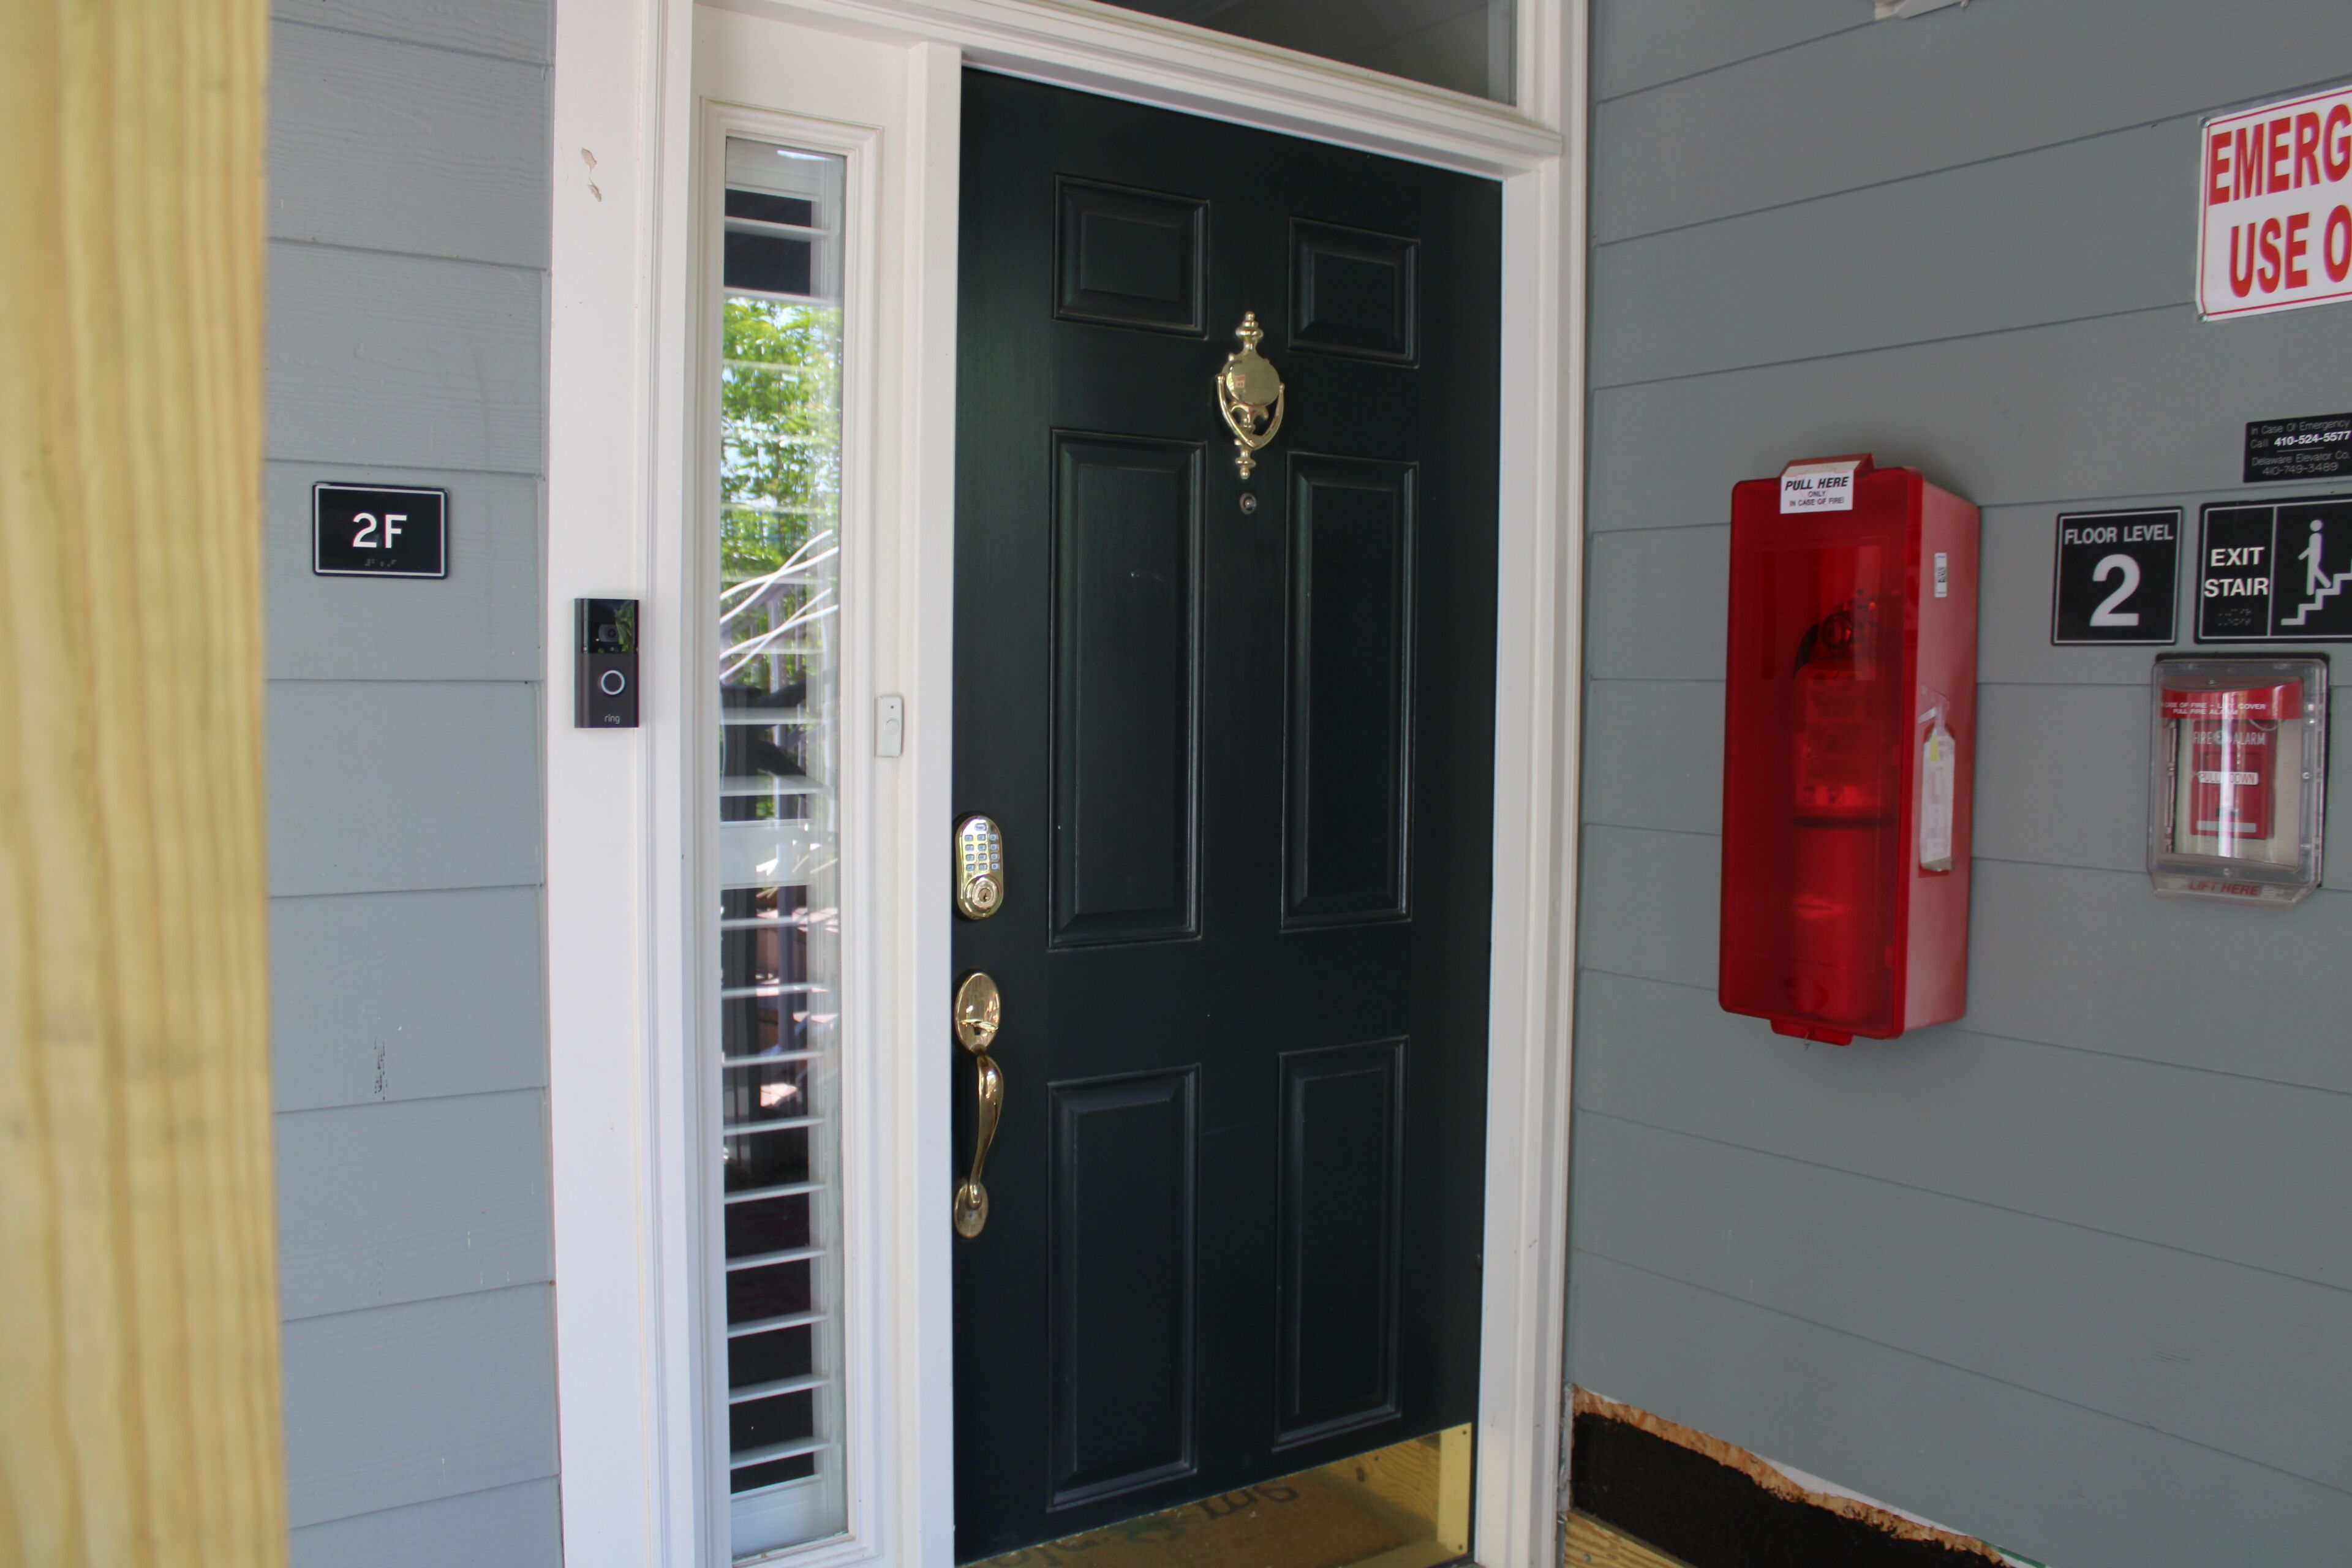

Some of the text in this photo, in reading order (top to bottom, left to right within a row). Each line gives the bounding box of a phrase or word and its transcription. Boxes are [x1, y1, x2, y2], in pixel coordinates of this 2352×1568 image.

[2208, 104, 2352, 206] EMERG
[2229, 205, 2352, 298] USE O
[2250, 426, 2258, 435] In
[2261, 424, 2283, 434] Case
[2299, 420, 2351, 431] Emergency
[2250, 431, 2352, 448] Call 410-524-5577
[2251, 450, 2350, 466] Delaware Elevator Co.
[2262, 462, 2339, 475] 410-749-3489
[1785, 476, 1849, 491] PULL HERE
[352, 512, 407, 549] 2F
[2065, 524, 2174, 545] FLOOR LEVEL
[2211, 546, 2265, 567] EXIT
[2089, 554, 2141, 627] 2
[2204, 578, 2269, 597] STAIR
[605, 714, 620, 724] ring
[2193, 731, 2266, 745] FIRE ALARM
[2189, 880, 2220, 892] LIFT
[2220, 883, 2260, 896] HERE
